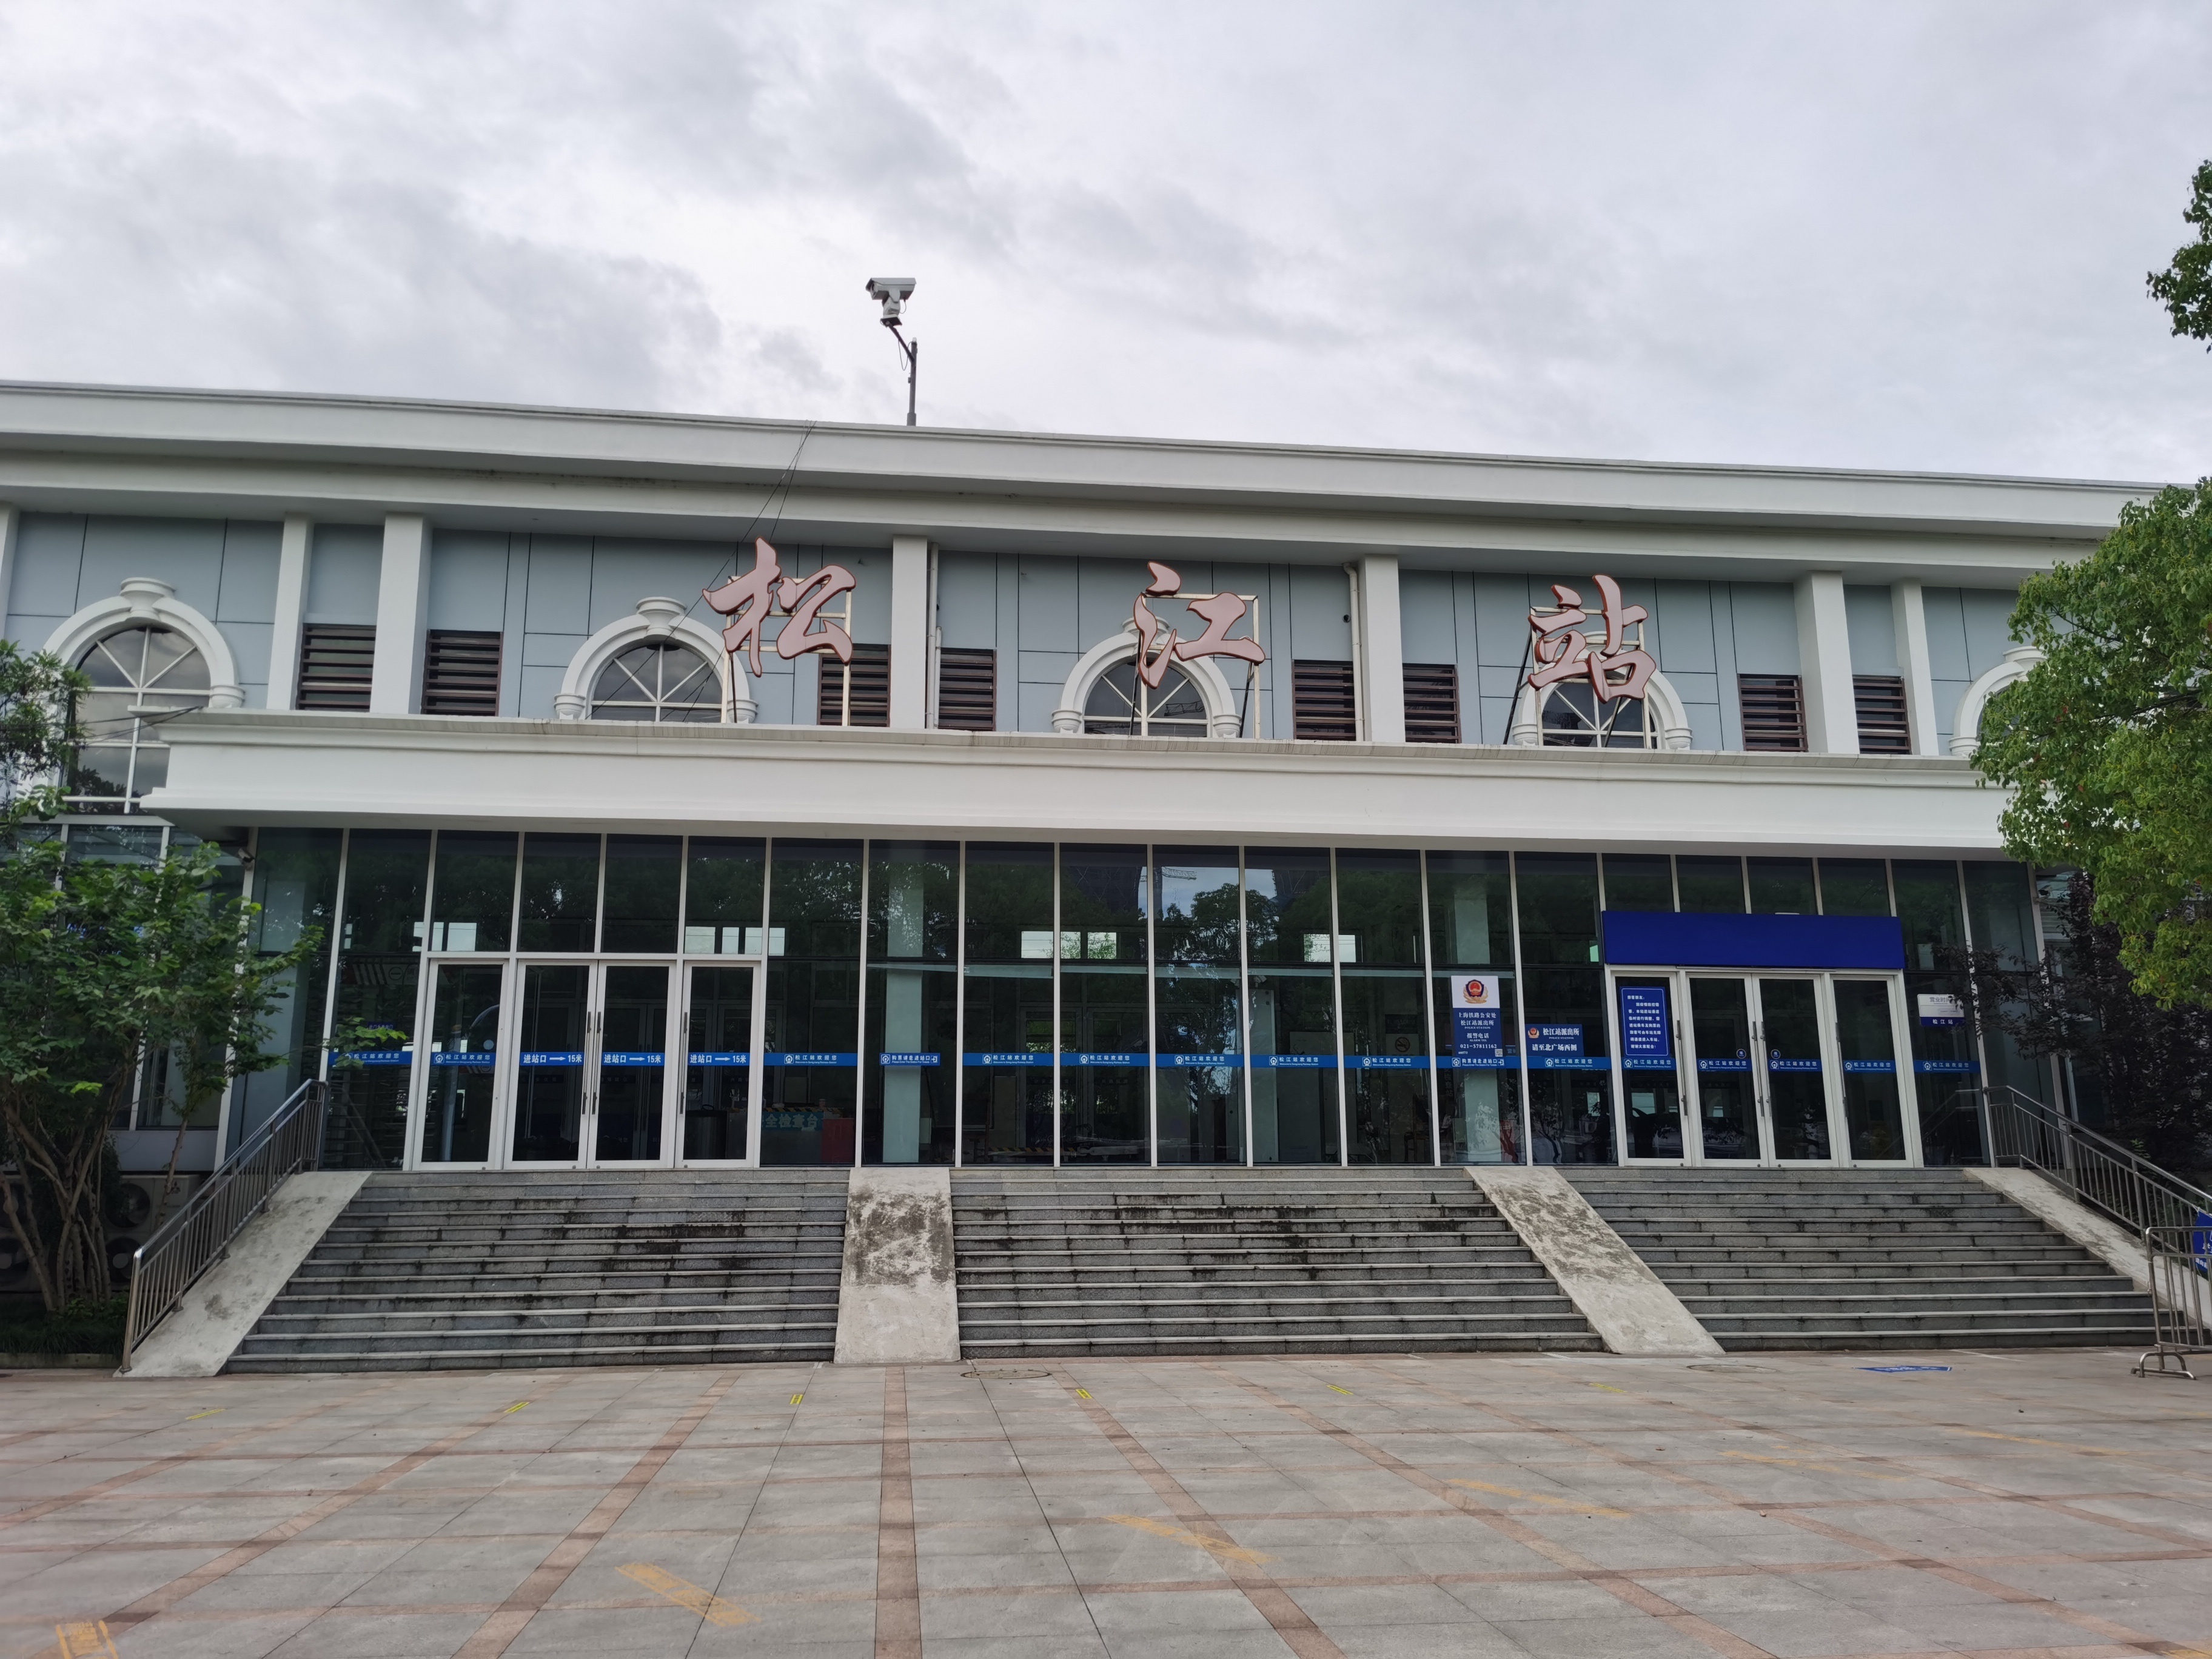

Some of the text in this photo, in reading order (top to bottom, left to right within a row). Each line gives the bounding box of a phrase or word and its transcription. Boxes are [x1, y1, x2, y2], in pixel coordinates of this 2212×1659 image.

[702, 537, 1657, 704] 松江站
[523, 1054, 583, 1063] 进站口 15米
[604, 1054, 662, 1063] 进站口 15米
[689, 1054, 746, 1064] 进站口 15米
[762, 1113, 818, 1128] 全检查台
